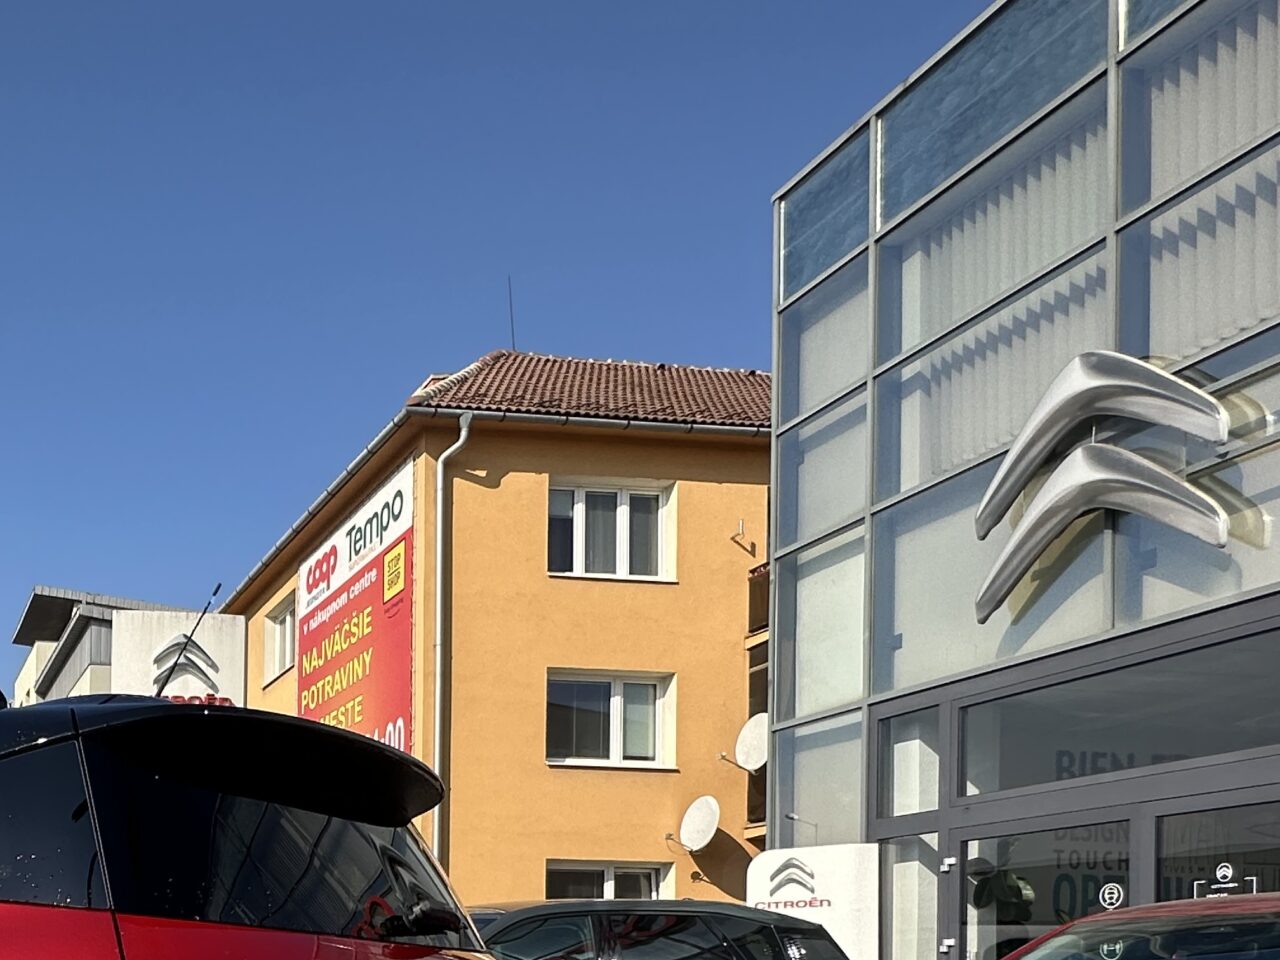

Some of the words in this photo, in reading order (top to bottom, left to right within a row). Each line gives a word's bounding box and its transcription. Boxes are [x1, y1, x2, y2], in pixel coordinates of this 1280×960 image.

[345, 489, 404, 562] Tempo
[349, 568, 378, 599] centre
[387, 553, 401, 573] STOP
[387, 571, 401, 591] SHOP
[302, 606, 373, 678] NAJVÄČŠIE
[301, 647, 374, 715] POTRAVINY
